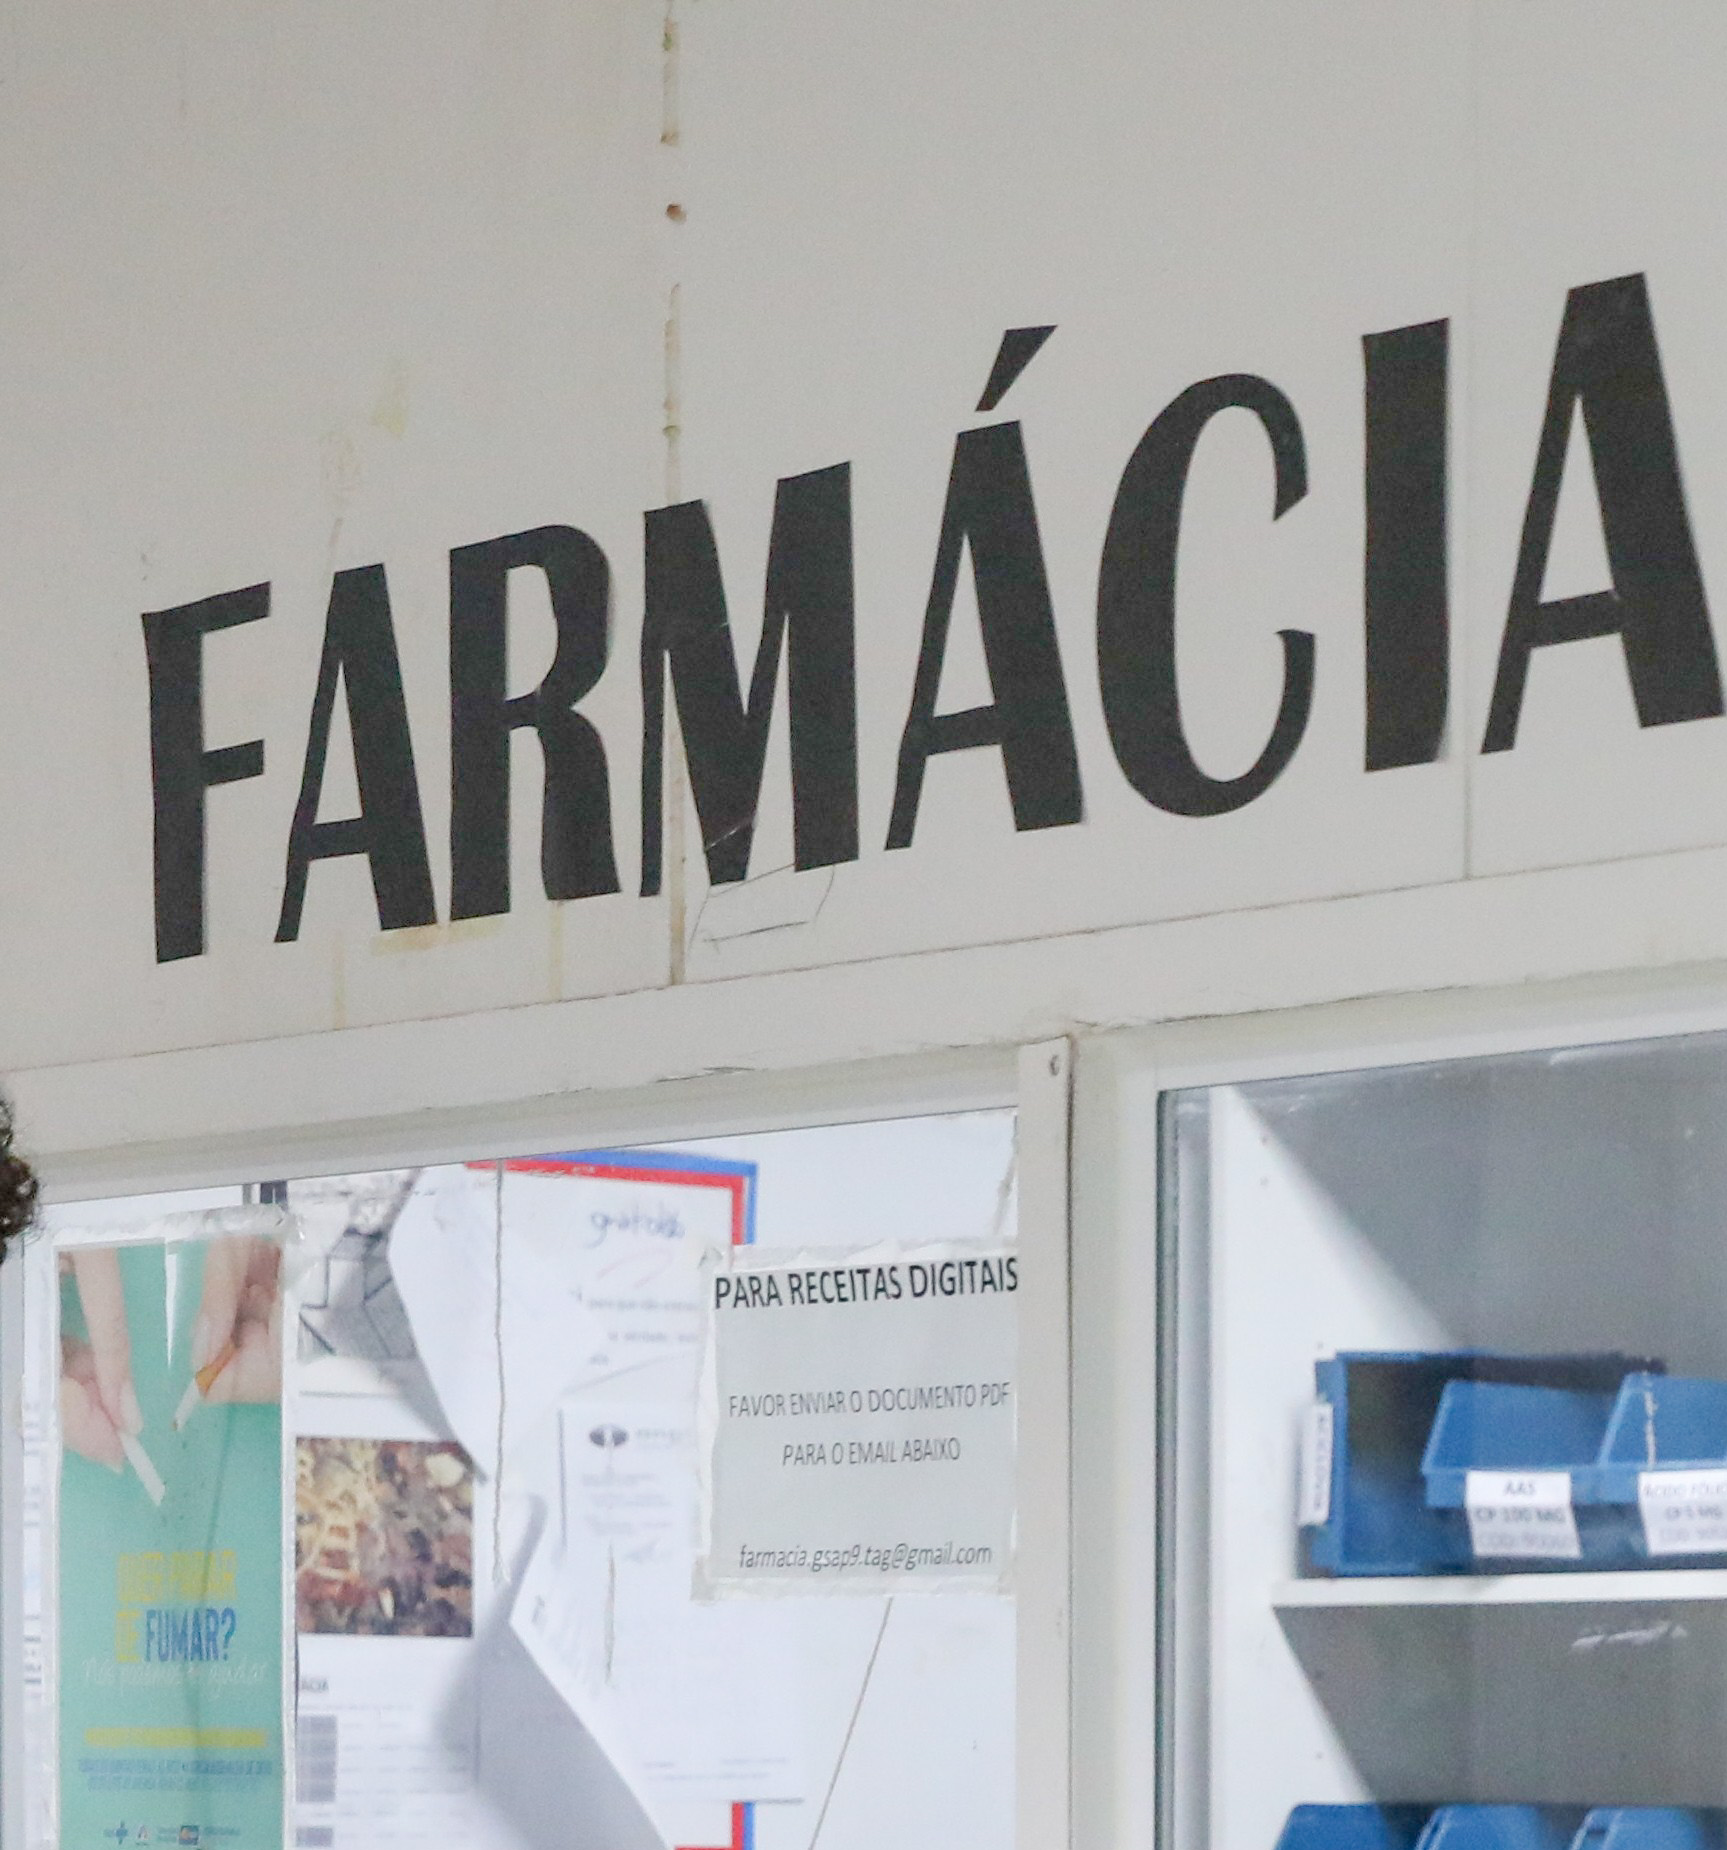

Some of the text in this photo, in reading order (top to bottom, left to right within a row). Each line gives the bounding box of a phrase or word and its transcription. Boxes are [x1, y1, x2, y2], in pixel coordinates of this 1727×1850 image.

[140, 272, 1727, 964] FARMÁCIA
[715, 1257, 1018, 1310] PARA RECEITAS DIGITAIS
[729, 1382, 1011, 1418] FAVOR ENVIAR O DOCUMENTO PDF
[782, 1437, 961, 1467] PARA O EMAIL ABAIXO
[1502, 1478, 1537, 1498] AAS
[738, 1541, 992, 1573] farmacia.gsap9.tag@gmail.com
[145, 1607, 237, 1663] FUMAR?
